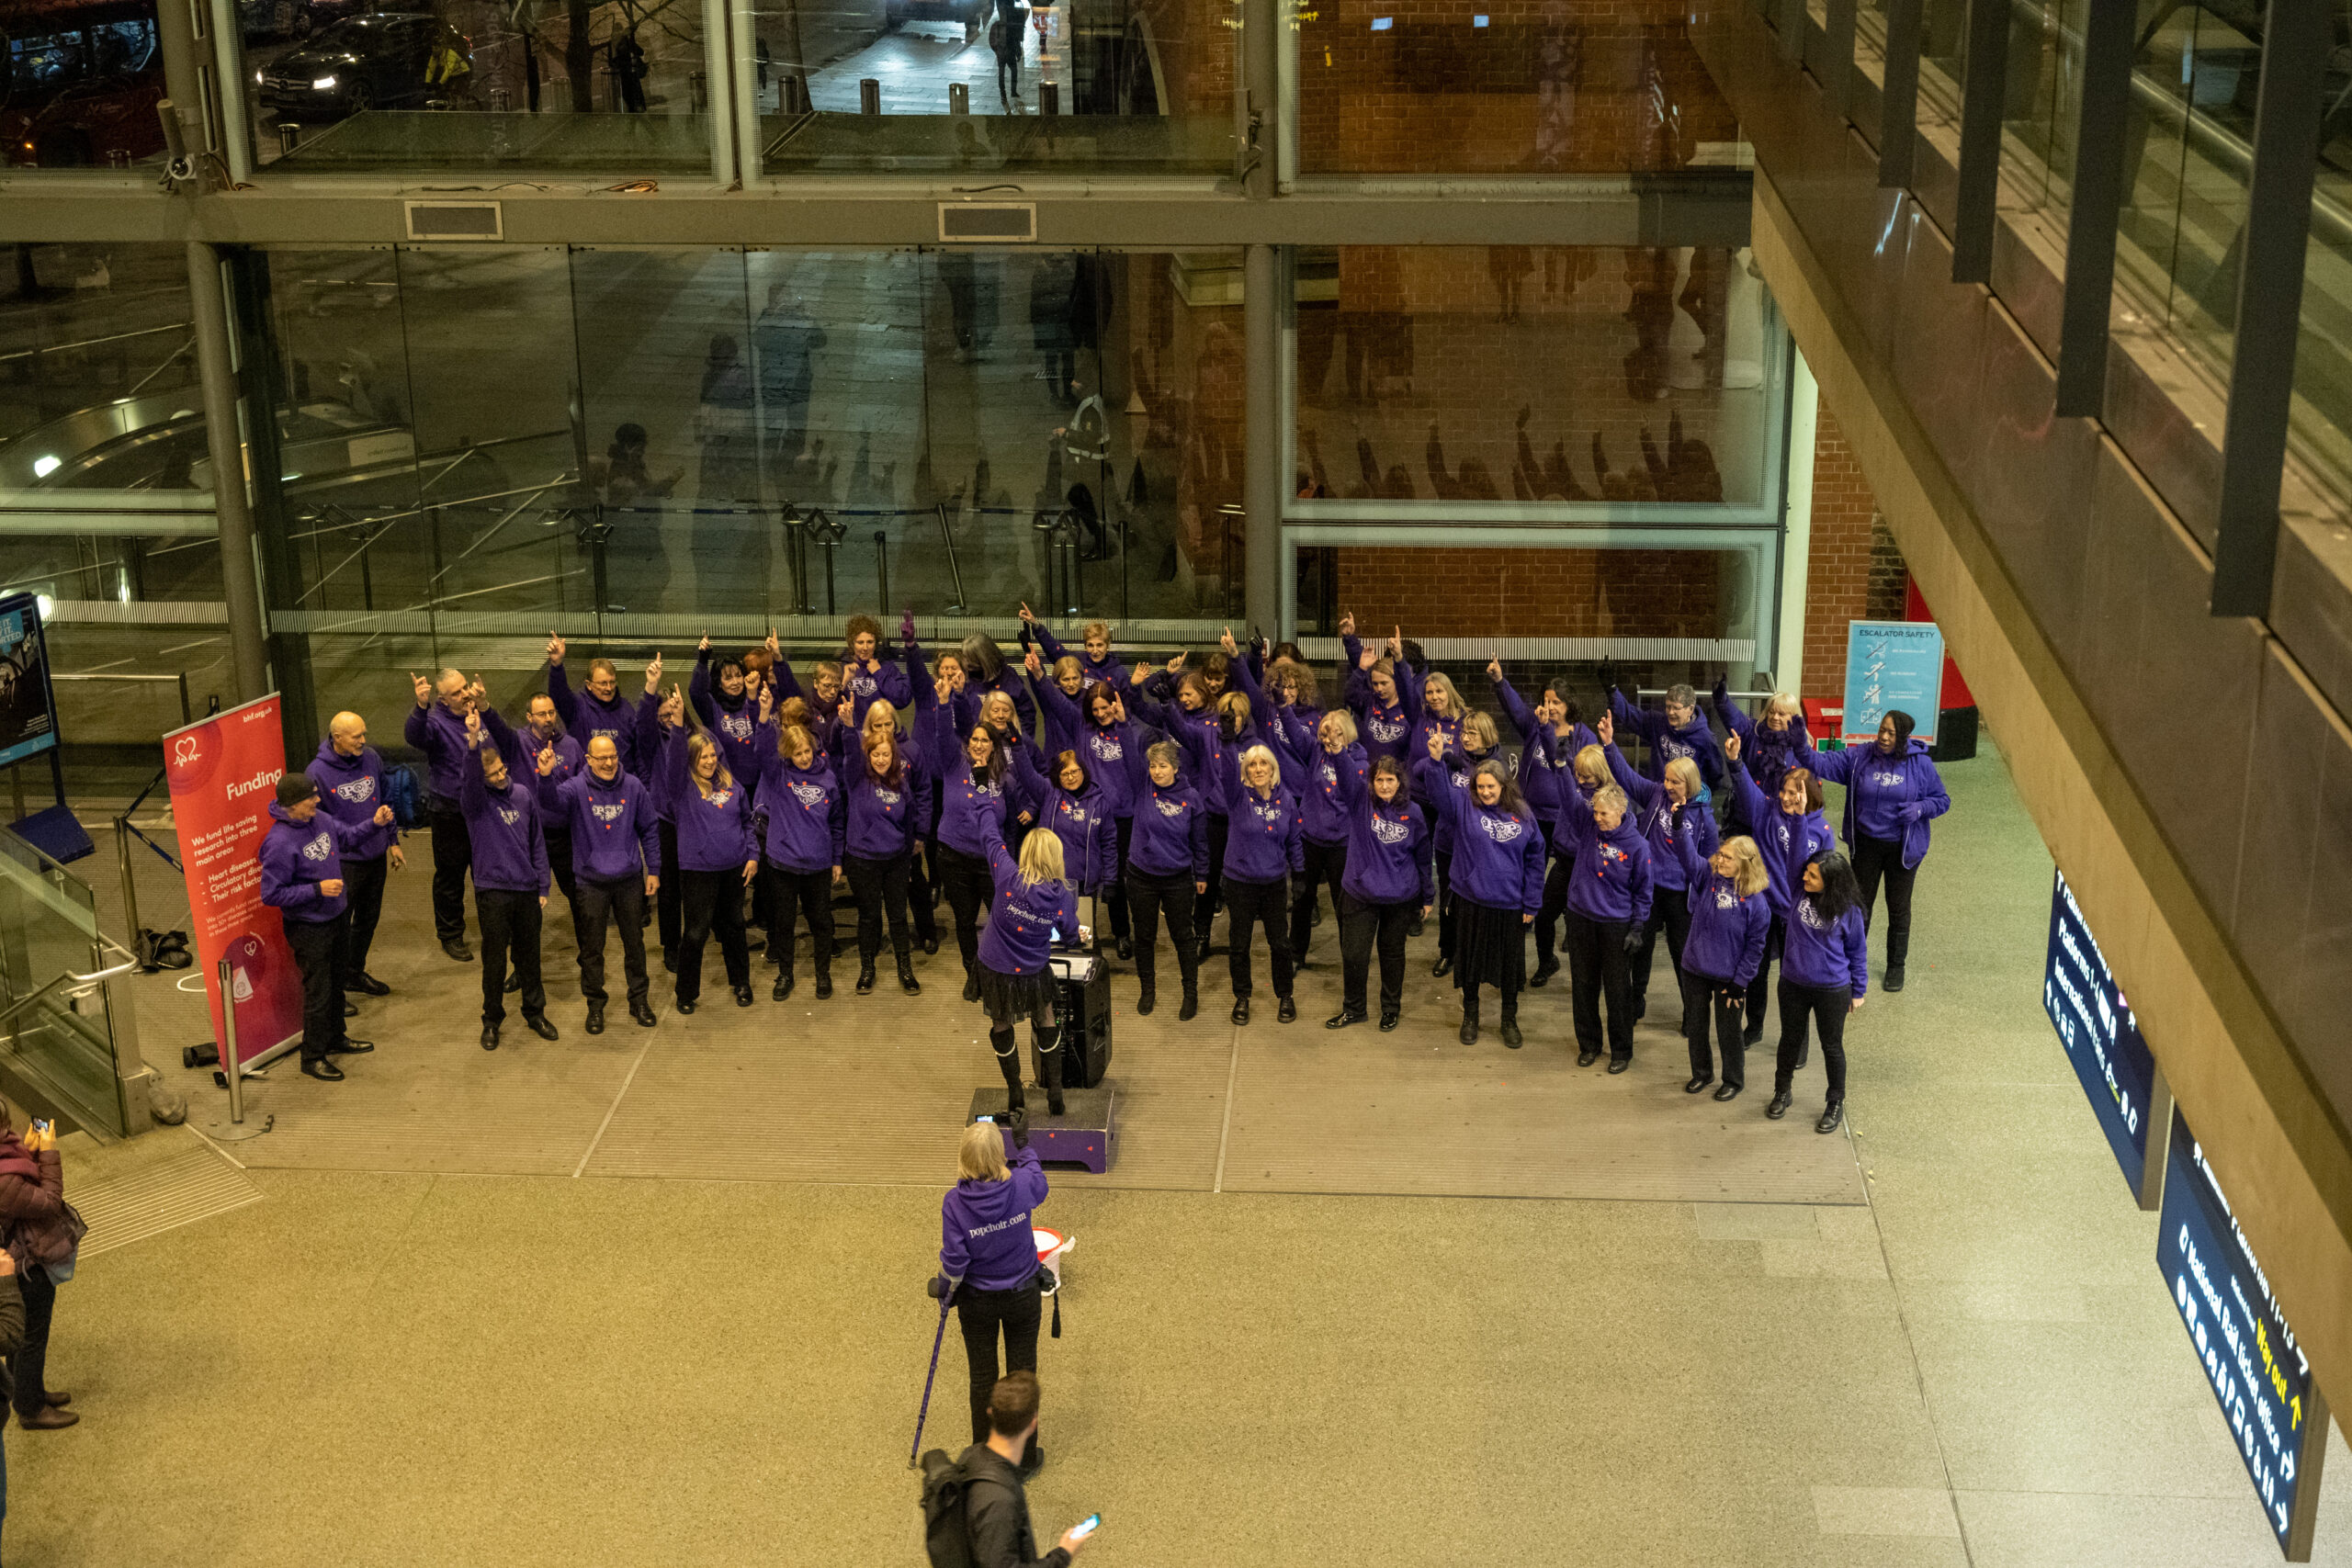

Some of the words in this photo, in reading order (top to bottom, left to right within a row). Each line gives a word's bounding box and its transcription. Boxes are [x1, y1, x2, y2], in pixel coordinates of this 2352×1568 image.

[1859, 629, 1905, 637] ESCALATOR
[1905, 630, 1935, 638] SAFETY
[243, 706, 273, 723] bhf.org.uk
[226, 768, 282, 801] Funding
[191, 836, 205, 847] We
[206, 829, 222, 841] fund
[223, 824, 234, 834] life
[235, 815, 257, 829] saving
[194, 840, 224, 857] research
[225, 833, 239, 843] into
[240, 825, 258, 838] three
[196, 854, 215, 867] main
[215, 846, 234, 859] areas
[209, 869, 229, 883] Heart
[229, 857, 257, 874] diseases
[209, 873, 247, 893] Circulatory
[247, 864, 264, 876] dise
[211, 890, 230, 903] Their
[231, 883, 243, 895] risk
[243, 874, 263, 889] facto
[1006, 904, 1054, 924] popchoir.com
[2058, 917, 2090, 982] Platforms
[2054, 955, 2094, 1038] International
[969, 1212, 1027, 1239] popchoir.com
[2187, 1239, 2223, 1324] National
[2222, 1304, 2239, 1358] Rail
[2237, 1340, 2260, 1405] ticket
[2257, 1395, 2280, 1455] office
[2256, 1316, 2274, 1376] Way
[2271, 1363, 2288, 1404] out
